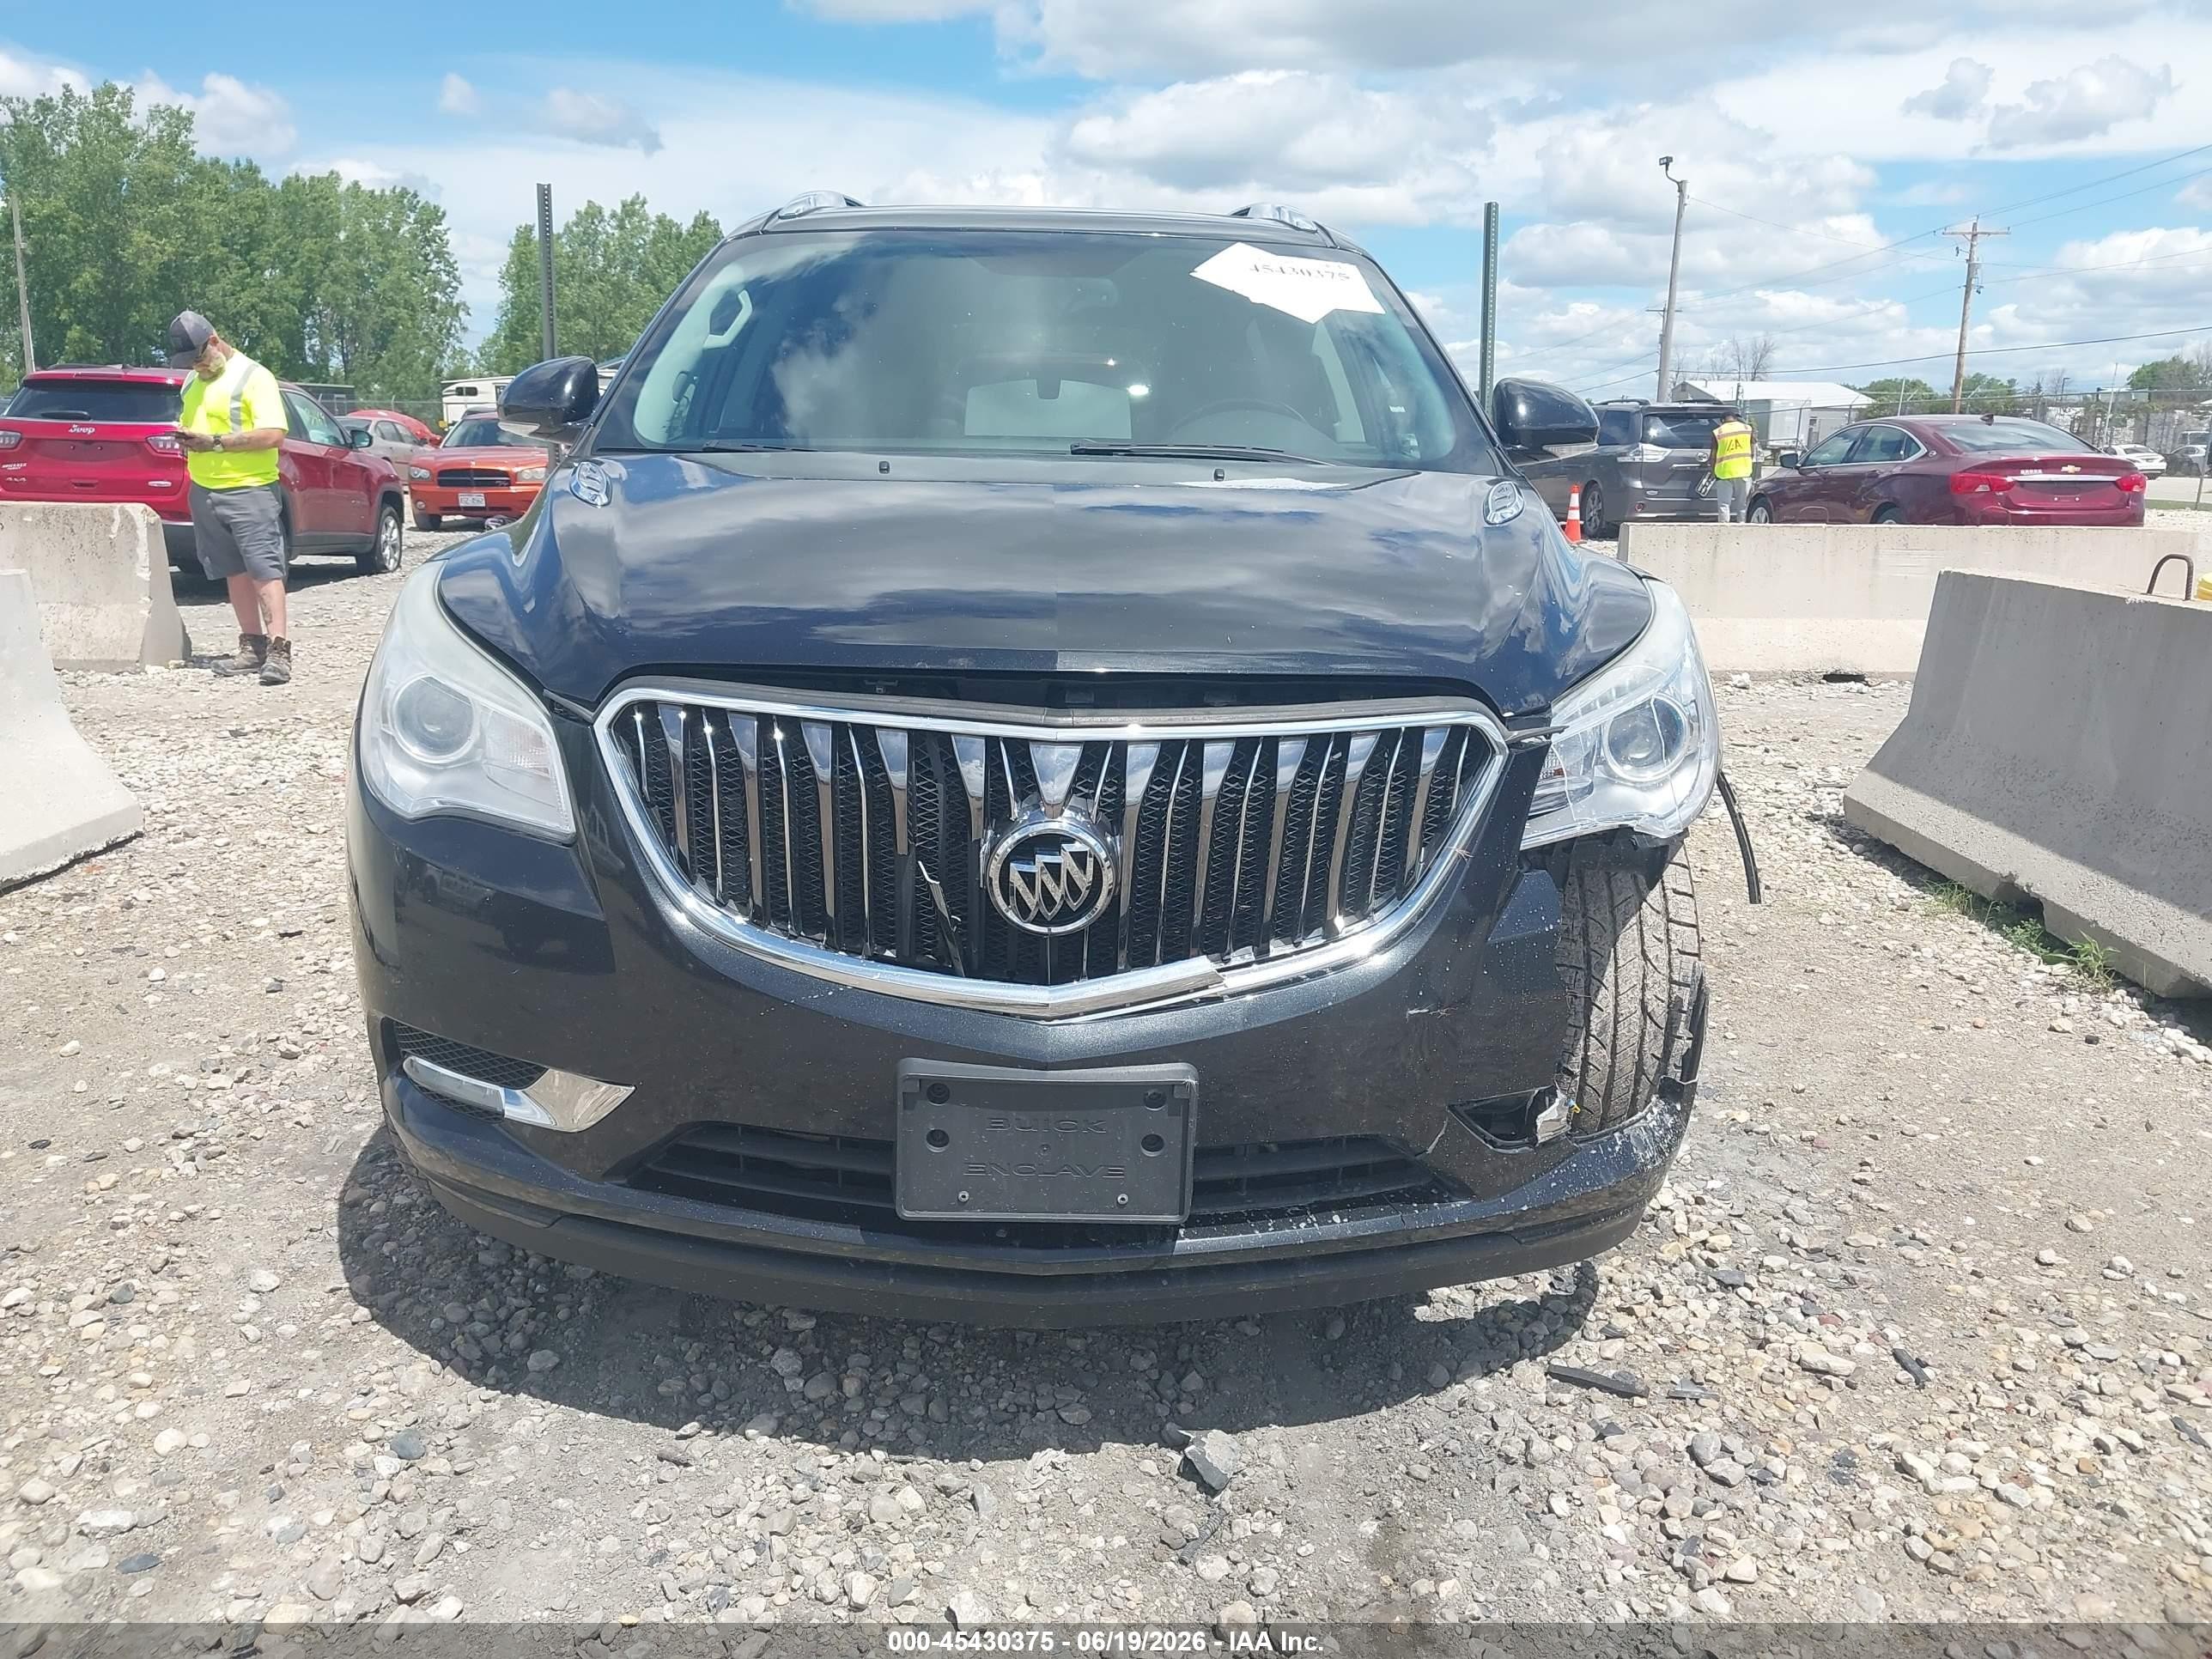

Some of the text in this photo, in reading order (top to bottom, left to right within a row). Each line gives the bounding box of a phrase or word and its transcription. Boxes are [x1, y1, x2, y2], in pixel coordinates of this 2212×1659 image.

[68, 424, 96, 434] Jeep
[985, 1116, 1108, 1134] BUICK
[963, 1162, 1126, 1179] ENCLAVE
